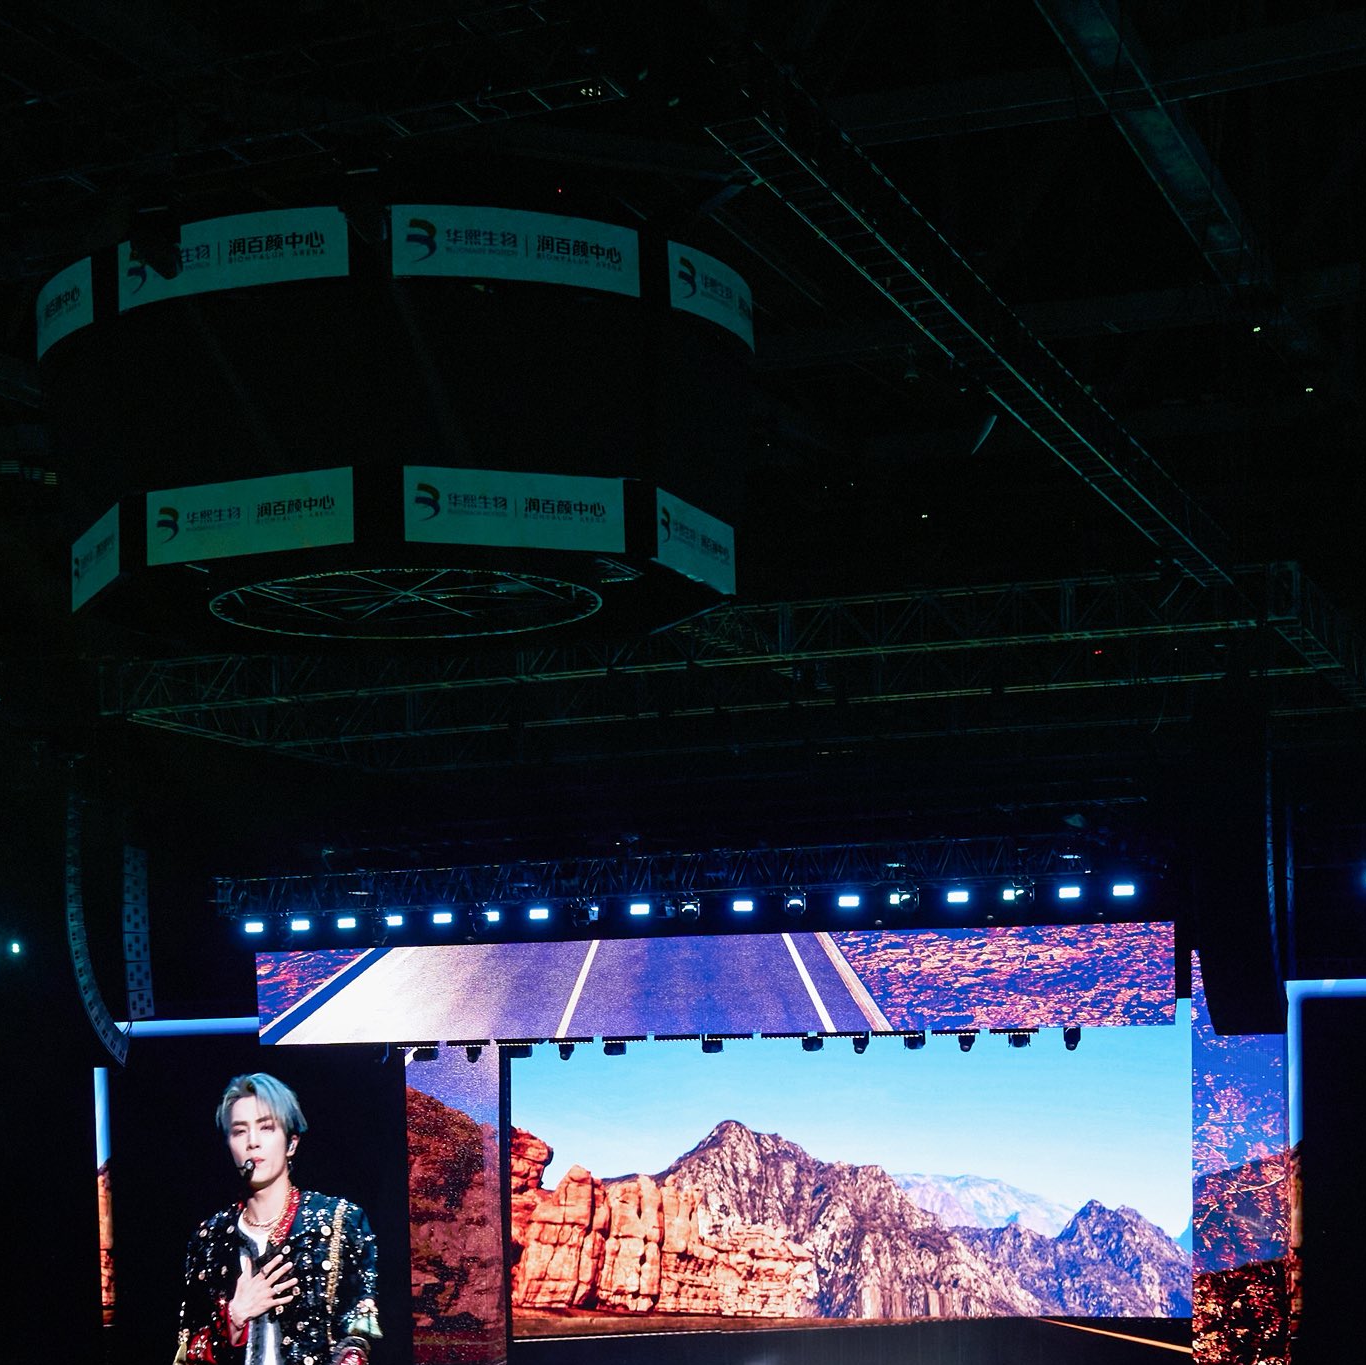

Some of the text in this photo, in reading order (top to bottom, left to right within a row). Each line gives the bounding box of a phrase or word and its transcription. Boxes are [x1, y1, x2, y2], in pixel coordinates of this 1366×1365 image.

[228, 231, 325, 257] 润百颜中心
[446, 228, 518, 248] 华熙生物
[537, 234, 623, 265] 润百颜中心
[187, 495, 336, 524] 华熙生物 润百颜中心
[448, 493, 508, 510] 华熙生物
[524, 497, 606, 517] 润百颜中心
